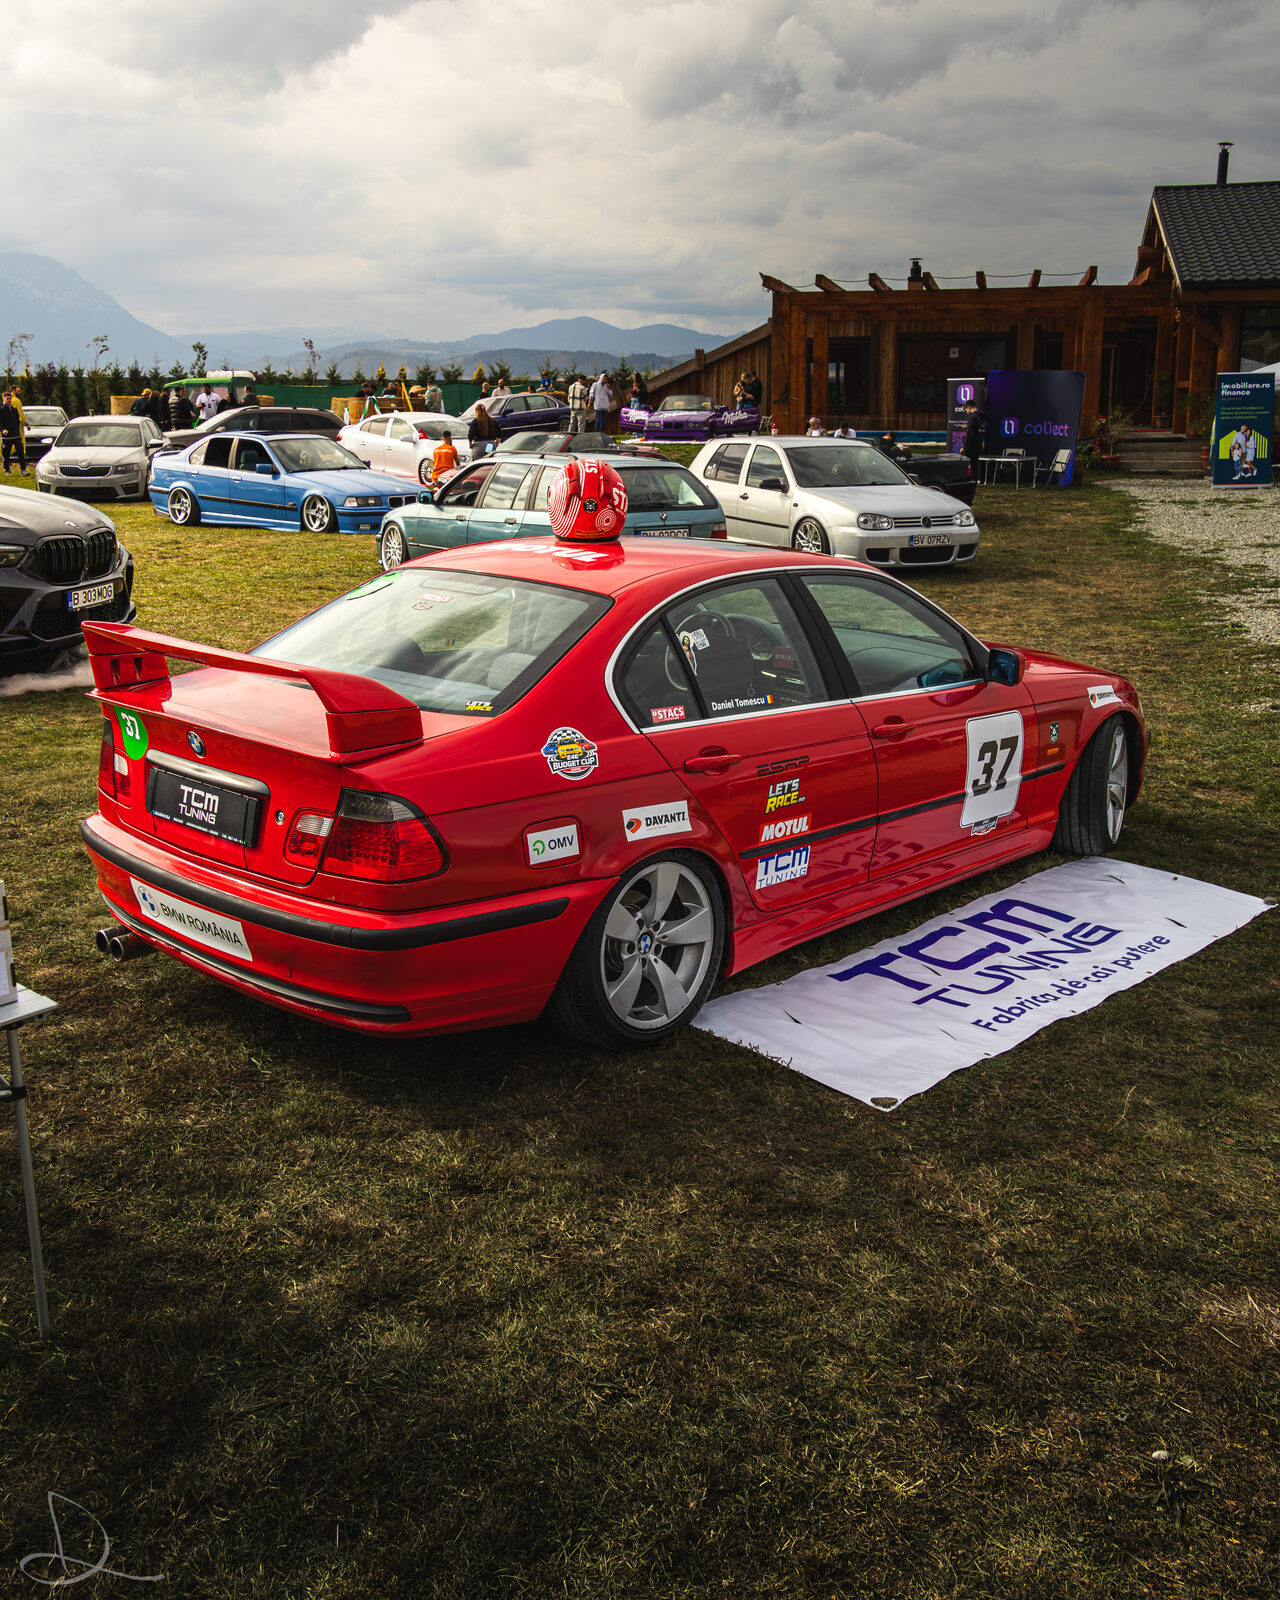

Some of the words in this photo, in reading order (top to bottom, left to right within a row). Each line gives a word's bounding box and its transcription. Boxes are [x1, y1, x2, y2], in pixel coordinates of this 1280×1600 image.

[1024, 420, 1070, 437] collect
[914, 536, 925, 545] BV
[73, 592, 80, 606] B
[657, 706, 685, 720] STACS
[712, 700, 734, 712] Daniel
[735, 697, 765, 708] Tomescu
[121, 712, 141, 741] 37
[553, 760, 580, 770] BUDGET
[581, 756, 595, 766] CUP
[972, 735, 1019, 797] 37
[769, 778, 800, 798] LET'S
[180, 784, 219, 814] TCM
[645, 811, 686, 827] DAVANTI
[761, 816, 809, 842] MOTUL
[548, 835, 574, 850] OMV
[760, 846, 809, 876] TCM
[758, 867, 807, 888] TUNING
[160, 903, 187, 925] BMW
[187, 914, 244, 947] ROMÂNIA
[826, 899, 1078, 991] TCM
[971, 992, 1061, 1032] Fabrica
[1050, 979, 1087, 997] de
[1083, 965, 1117, 983] cai
[1111, 935, 1171, 970] putere
